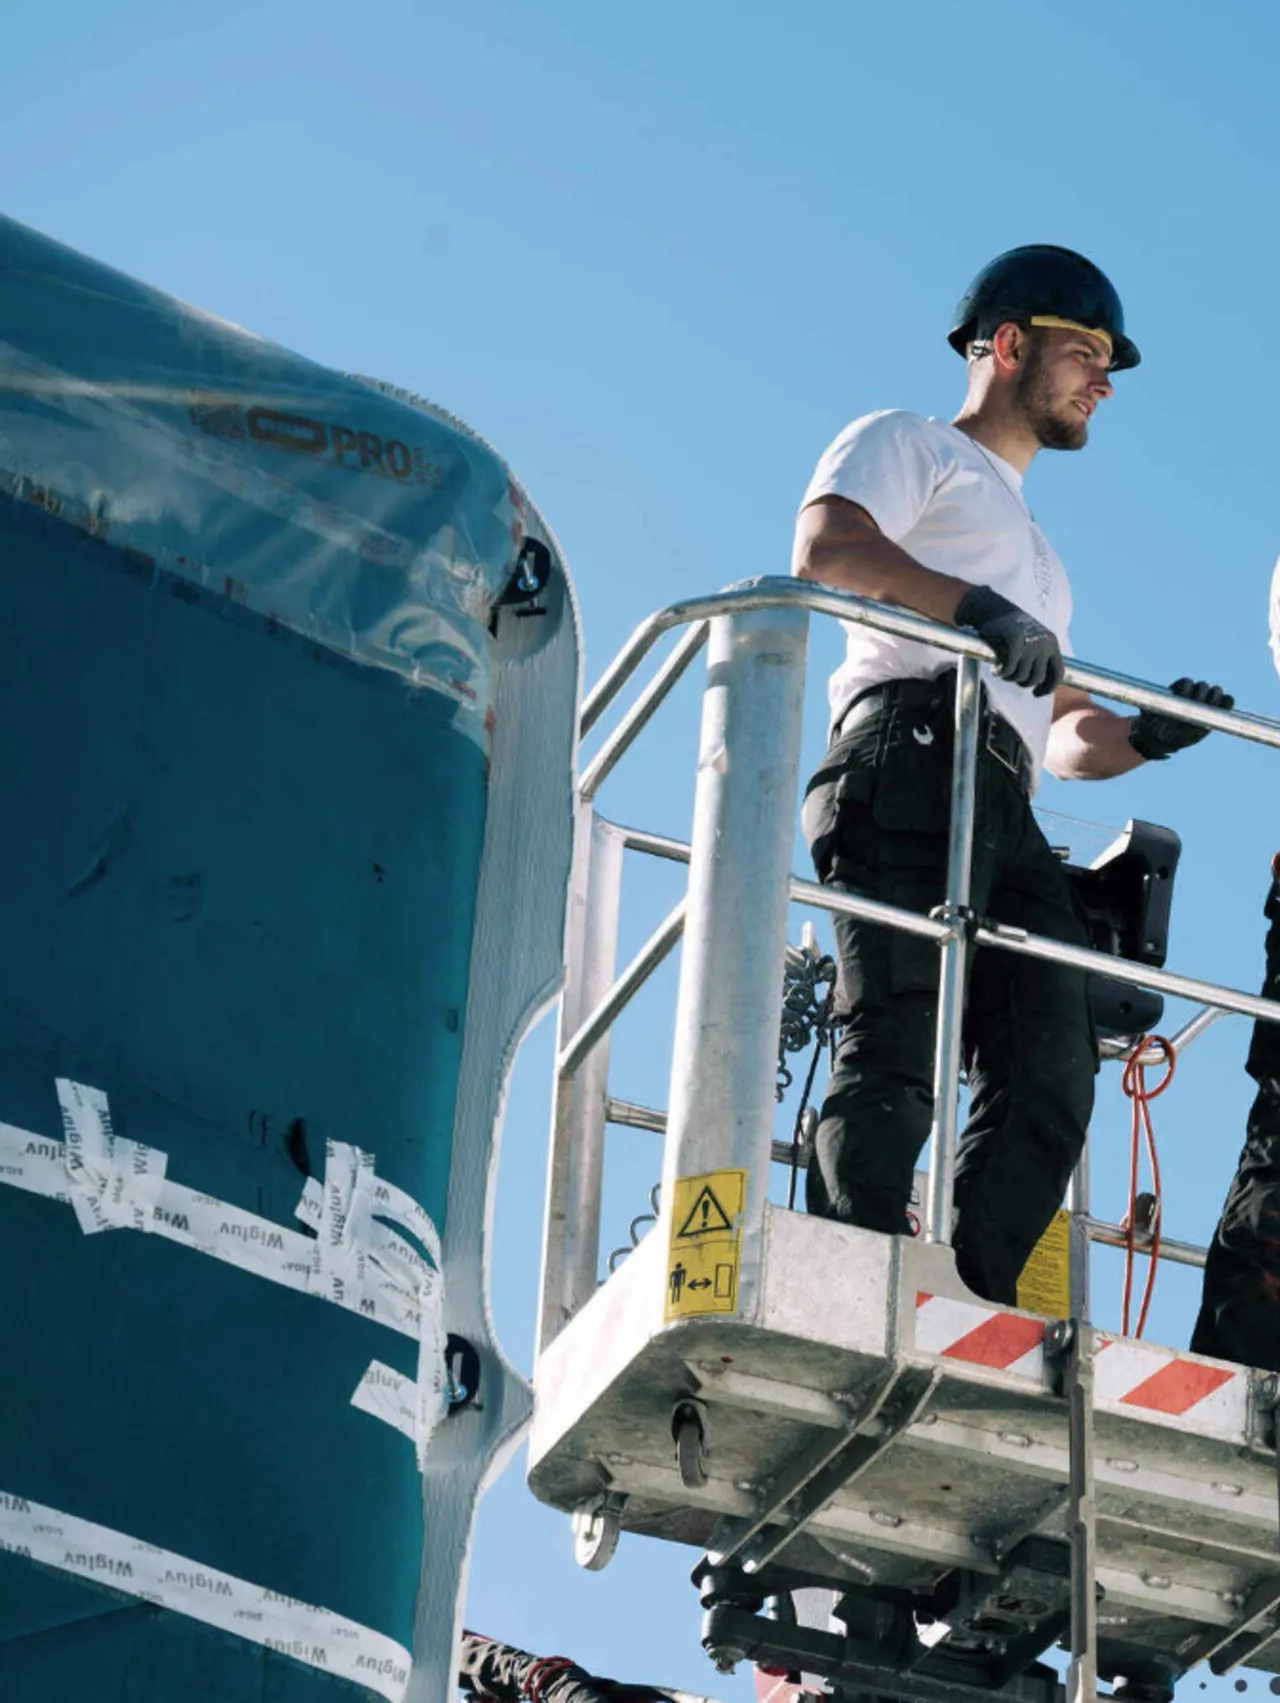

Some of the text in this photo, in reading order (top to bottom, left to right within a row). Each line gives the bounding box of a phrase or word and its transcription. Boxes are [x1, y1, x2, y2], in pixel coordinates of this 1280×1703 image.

[220, 1221, 285, 1250] Wigluv
[64, 1550, 133, 1578] Wigluv
[165, 1569, 233, 1597] Wigluv
